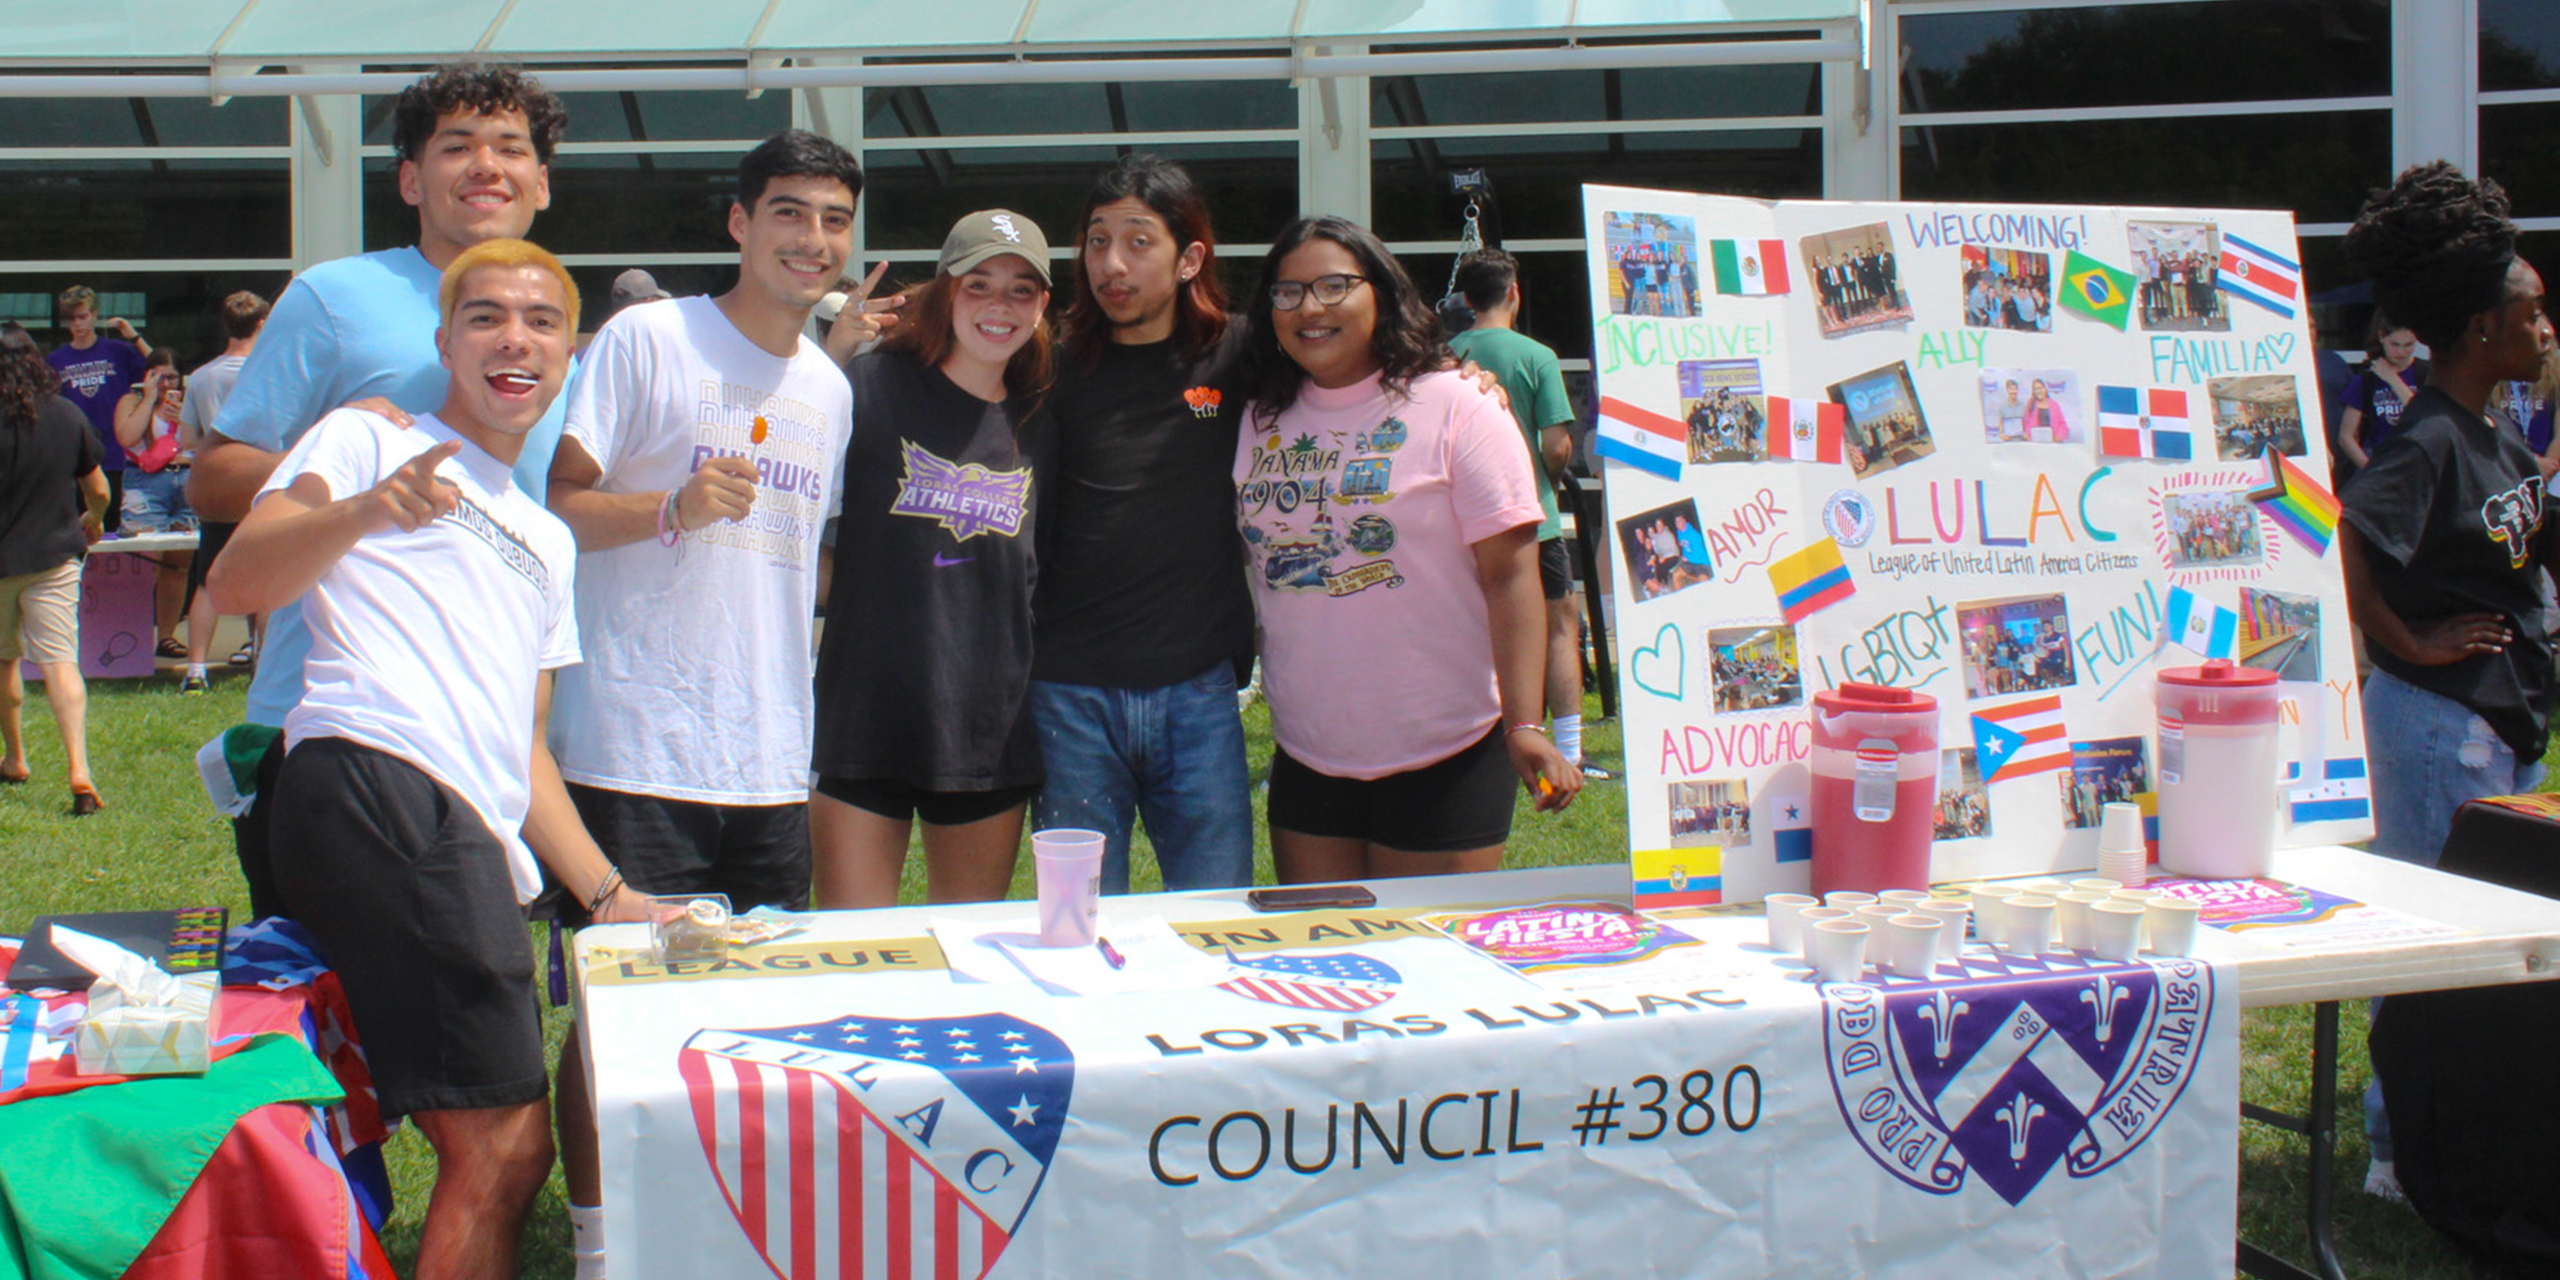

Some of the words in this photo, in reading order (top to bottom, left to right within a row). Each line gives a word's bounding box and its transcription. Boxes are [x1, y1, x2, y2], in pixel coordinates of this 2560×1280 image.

[1905, 212, 2088, 250] WELCOMING!
[1597, 315, 1772, 373] INCLUSIVE!
[1917, 330, 1989, 369] ALLY
[2150, 334, 2273, 384] FAMILIA
[71, 375, 106, 388] PRIDE
[1249, 447, 1341, 478] PANAMA
[899, 486, 1020, 528] ATHLETICS
[914, 478, 959, 493] LORAS
[963, 487, 1017, 506] COLLEGE
[1239, 478, 1328, 517] 1904
[1886, 467, 2117, 547] LULAC
[1707, 488, 1788, 568] AMOR
[1869, 551, 1921, 580] League
[1921, 551, 1940, 573] of
[1942, 550, 1992, 575] United
[1997, 550, 2035, 574] Latin
[2085, 551, 2140, 572] Citizens
[2076, 579, 2162, 686] FUN!
[1467, 911, 1624, 937] LATINX
[1483, 921, 1632, 946] FIESTA
[619, 946, 919, 979] LEAGUE
[1145, 1013, 1448, 1057] LORAS
[1462, 988, 1748, 1031] LULAC
[1147, 1088, 1545, 1188] COUNCIL
[1570, 1064, 1763, 1147] #380
[1858, 1086, 1937, 1172] PRO
